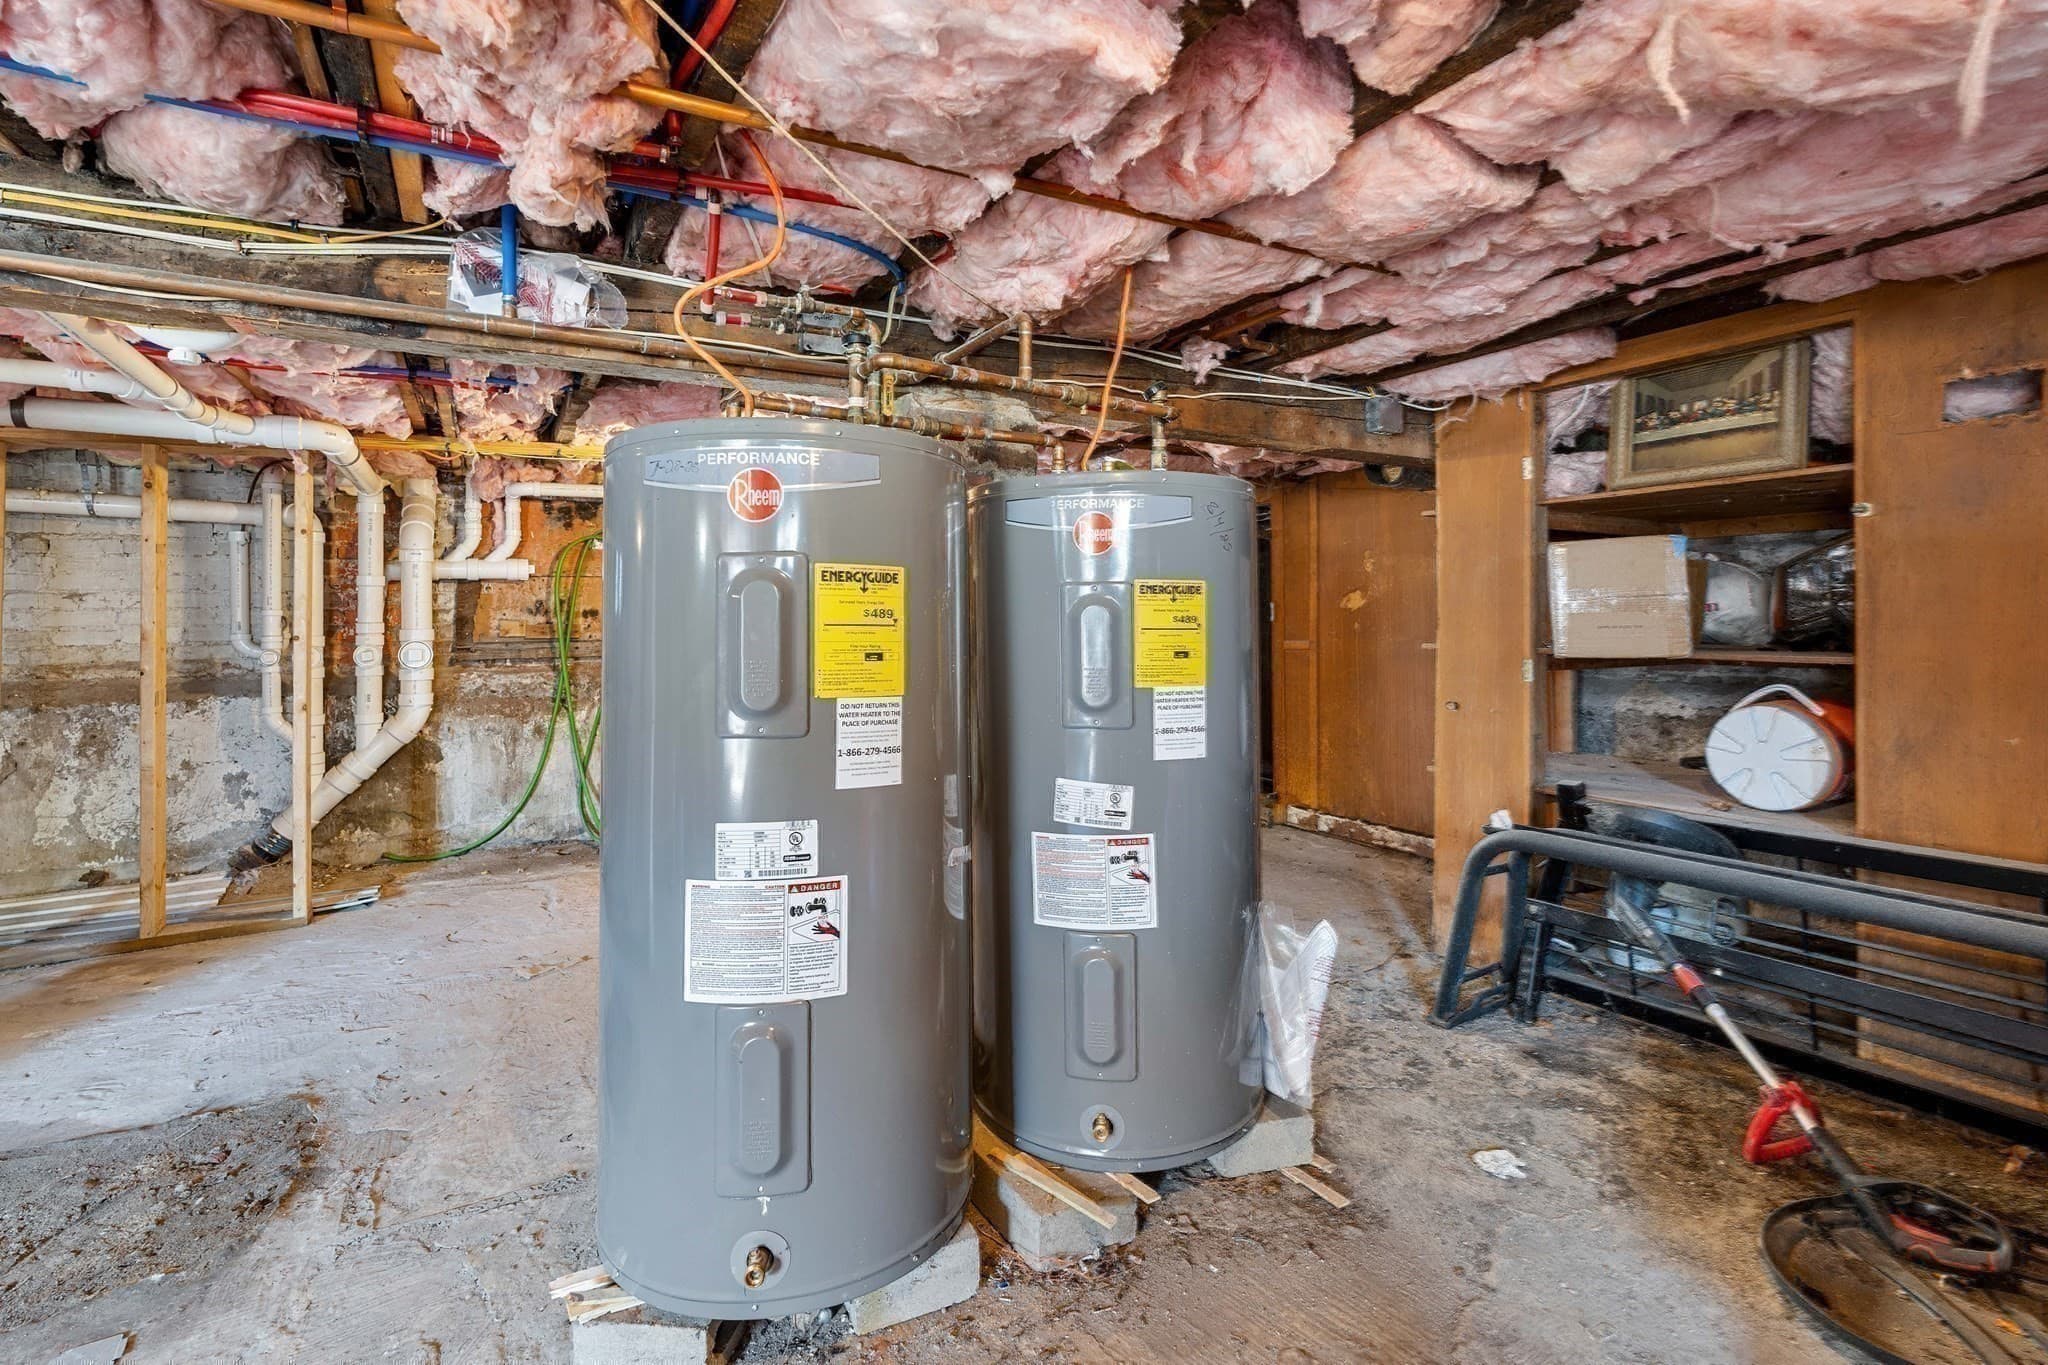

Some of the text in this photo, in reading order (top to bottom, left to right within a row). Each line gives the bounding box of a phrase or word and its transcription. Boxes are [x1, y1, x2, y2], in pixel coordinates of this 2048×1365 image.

[698, 452, 820, 466] PERFORMANCE
[734, 472, 780, 513] Rheem
[821, 570, 899, 584] ENERGYGUIDE
[1139, 584, 1201, 594] ENERGYGUIDE
[838, 746, 901, 757] 1-866-279-4566
[800, 882, 838, 891] DANGER
